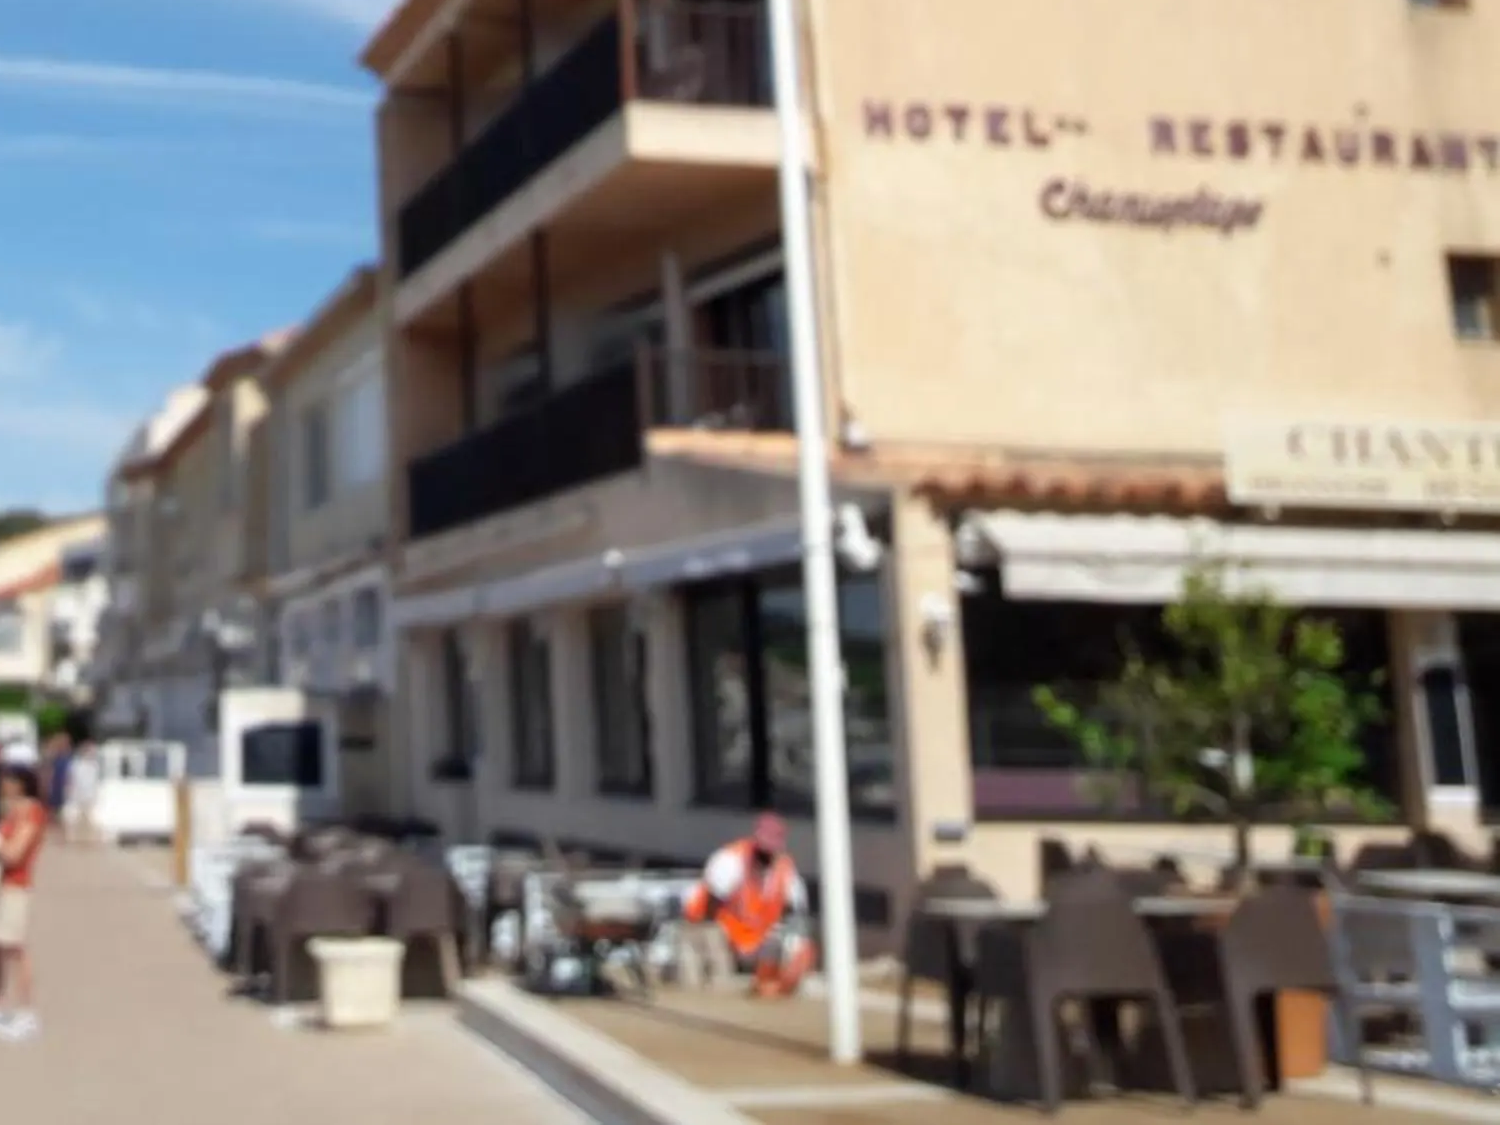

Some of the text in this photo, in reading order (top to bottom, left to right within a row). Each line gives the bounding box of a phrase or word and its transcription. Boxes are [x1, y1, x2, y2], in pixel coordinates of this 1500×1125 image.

[864, 101, 1500, 170] HOTEL RESTAURANT
[1285, 425, 1500, 471] CHANT
